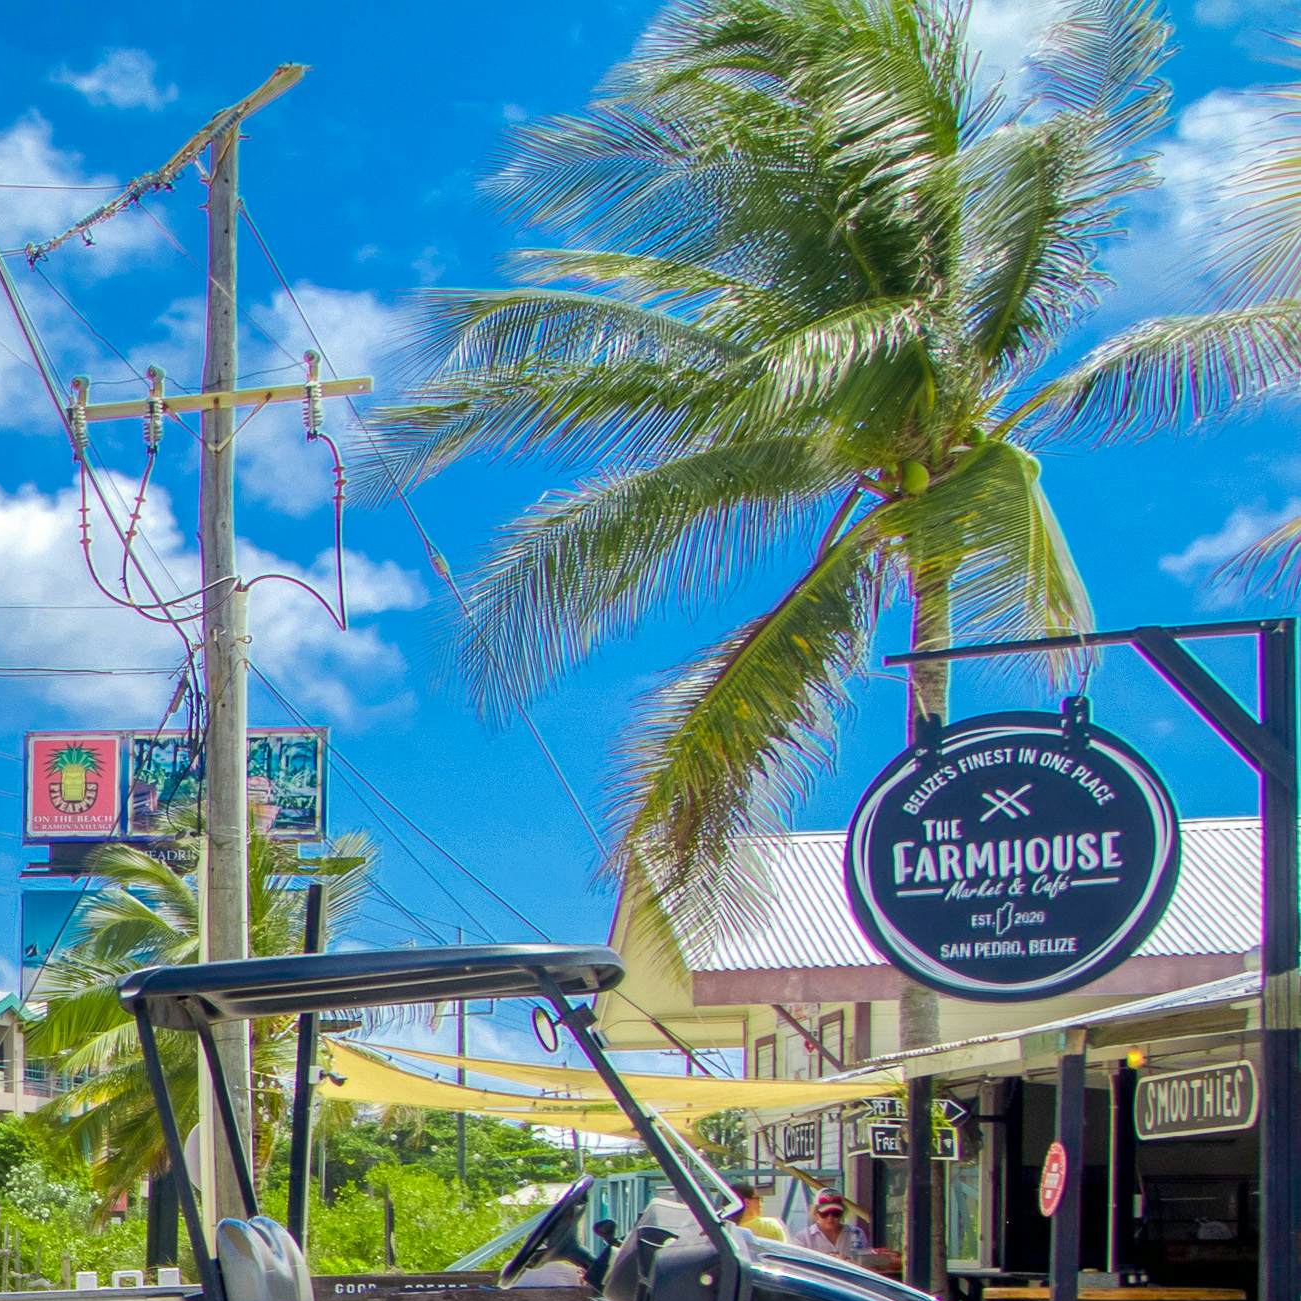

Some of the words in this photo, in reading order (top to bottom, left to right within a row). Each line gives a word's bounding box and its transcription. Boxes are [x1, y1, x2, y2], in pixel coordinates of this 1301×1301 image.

[902, 765, 958, 815] BELIZE'S
[958, 747, 1014, 774] FINEST
[1018, 747, 1037, 765] IN
[1039, 751, 1074, 775] ONE
[1070, 764, 1115, 807] PLACE
[49, 783, 98, 814] PINEAPPLES
[34, 815, 50, 823] ON
[53, 815, 73, 823] THE
[77, 815, 113, 823] BEACH
[921, 819, 963, 842] THE
[892, 831, 1124, 885] FARMHOUSE
[944, 880, 1003, 901] Market
[1007, 877, 1025, 895] &
[1031, 873, 1071, 900] Café
[971, 913, 996, 929] EST.
[1013, 911, 1046, 925] 2020
[940, 943, 973, 960] SAN
[974, 941, 1026, 958] PEDRO,
[1029, 937, 1077, 955] BELIZE
[871, 1099, 890, 1116] PET
[785, 1122, 815, 1158] COFFEE
